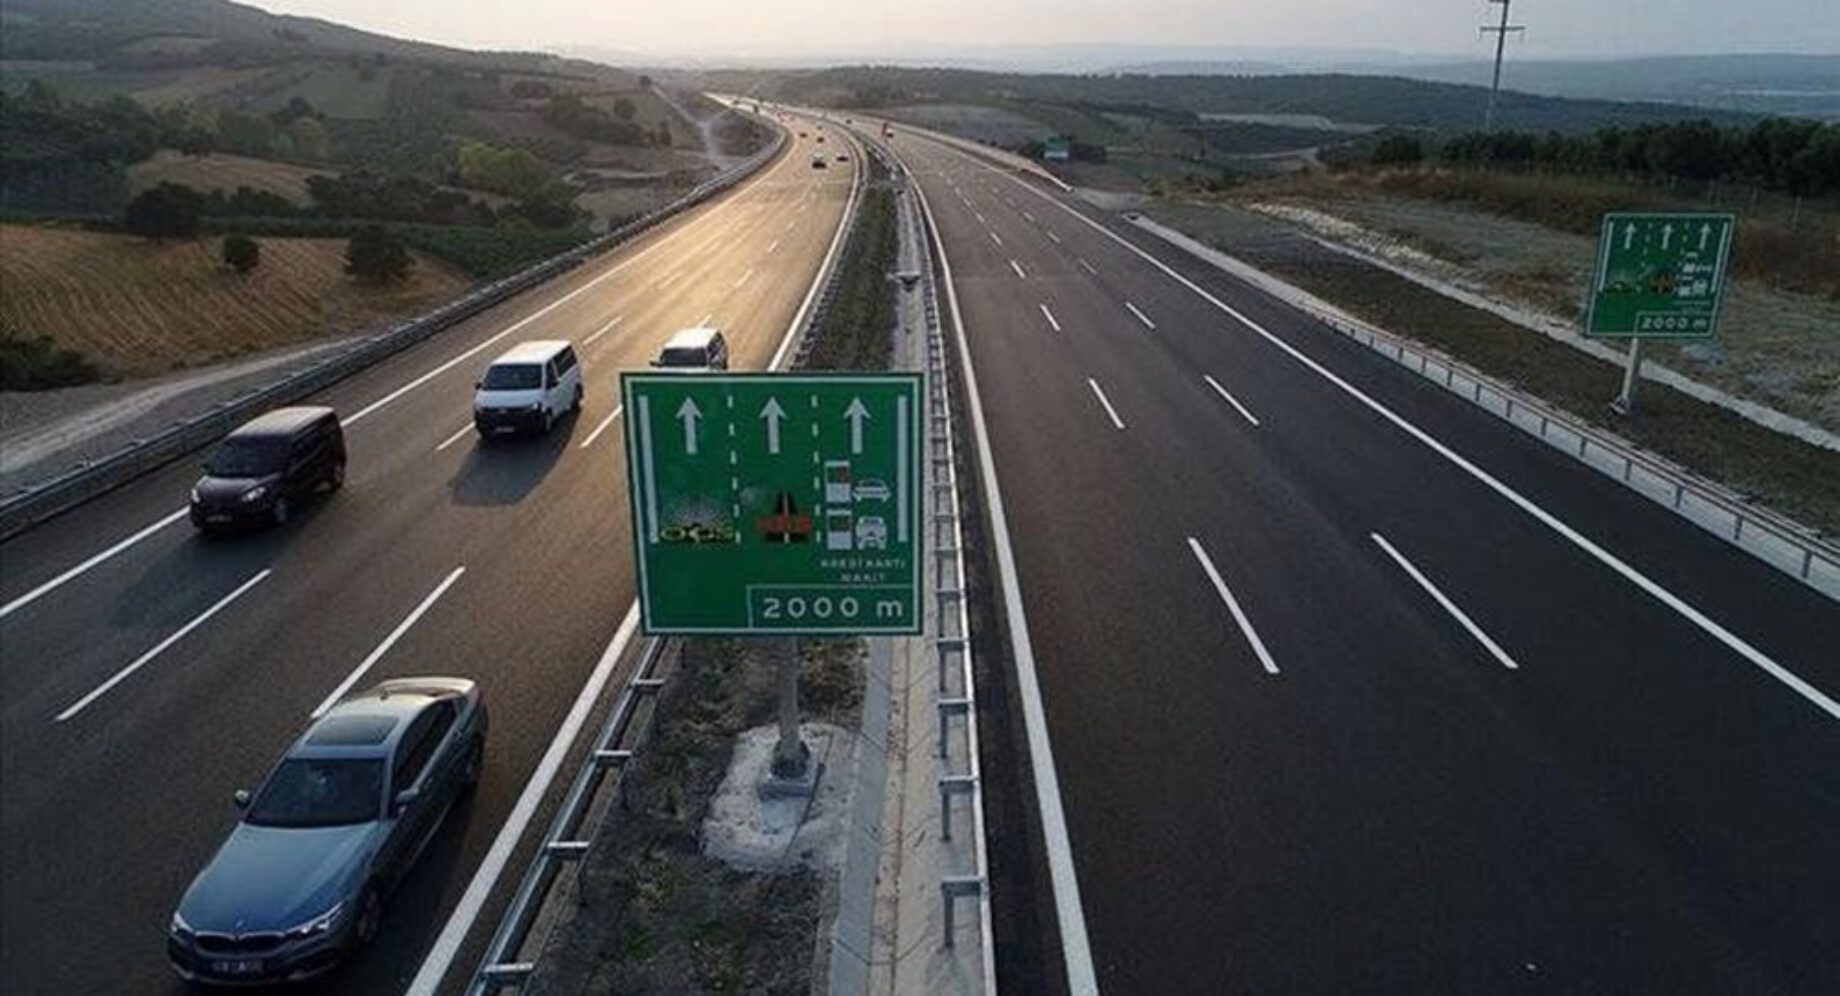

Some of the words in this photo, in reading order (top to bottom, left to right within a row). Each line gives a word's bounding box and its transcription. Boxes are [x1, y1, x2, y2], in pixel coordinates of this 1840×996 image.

[1641, 317, 1689, 330] 2000
[763, 598, 859, 618] 2000
[877, 601, 902, 618] m
